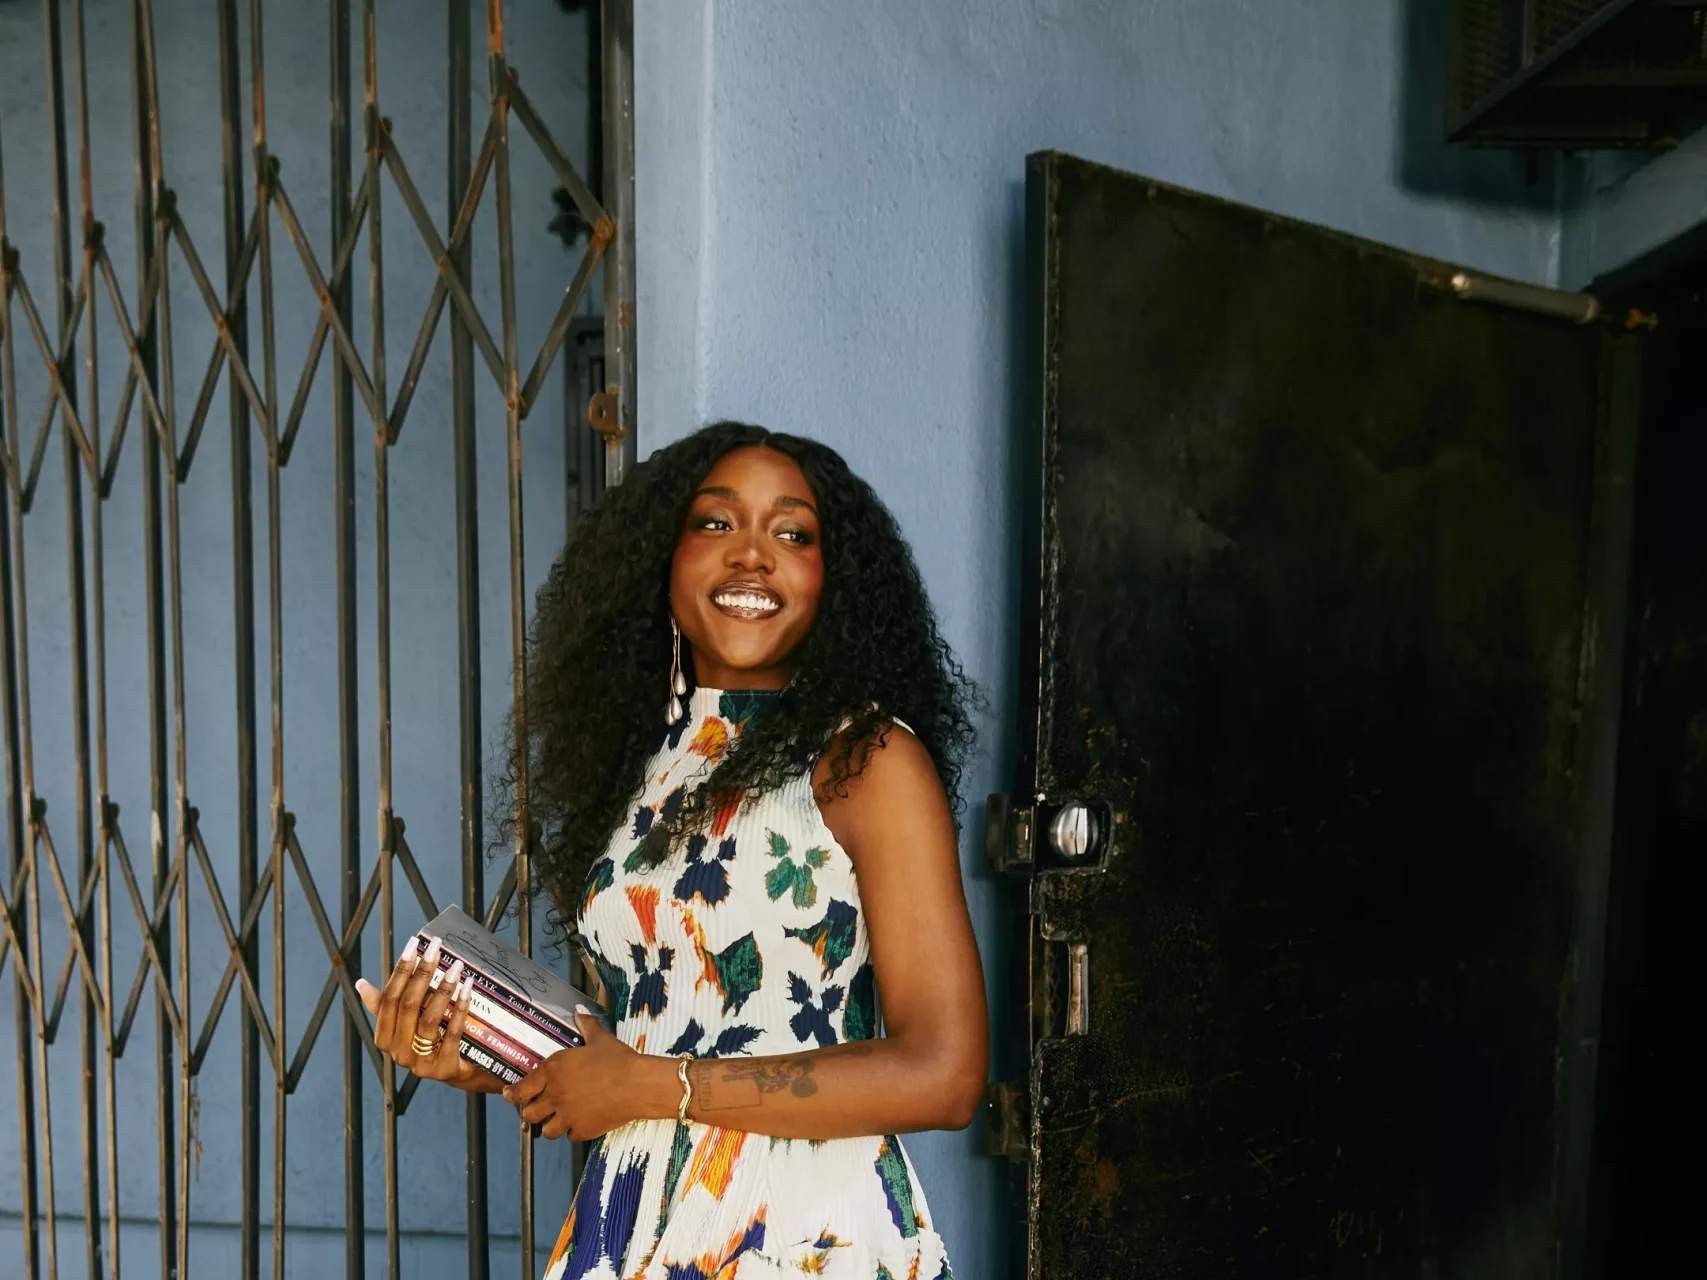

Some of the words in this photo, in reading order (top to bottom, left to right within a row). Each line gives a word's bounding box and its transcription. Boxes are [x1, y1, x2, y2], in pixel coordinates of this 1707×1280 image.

[478, 976, 498, 993] EYE
[508, 995, 526, 1011] Toni
[525, 1006, 562, 1034] Morrison
[467, 1046, 494, 1069] MASKS
[491, 1061, 505, 1075] BY
[487, 1034, 530, 1067] FEMINISM.
